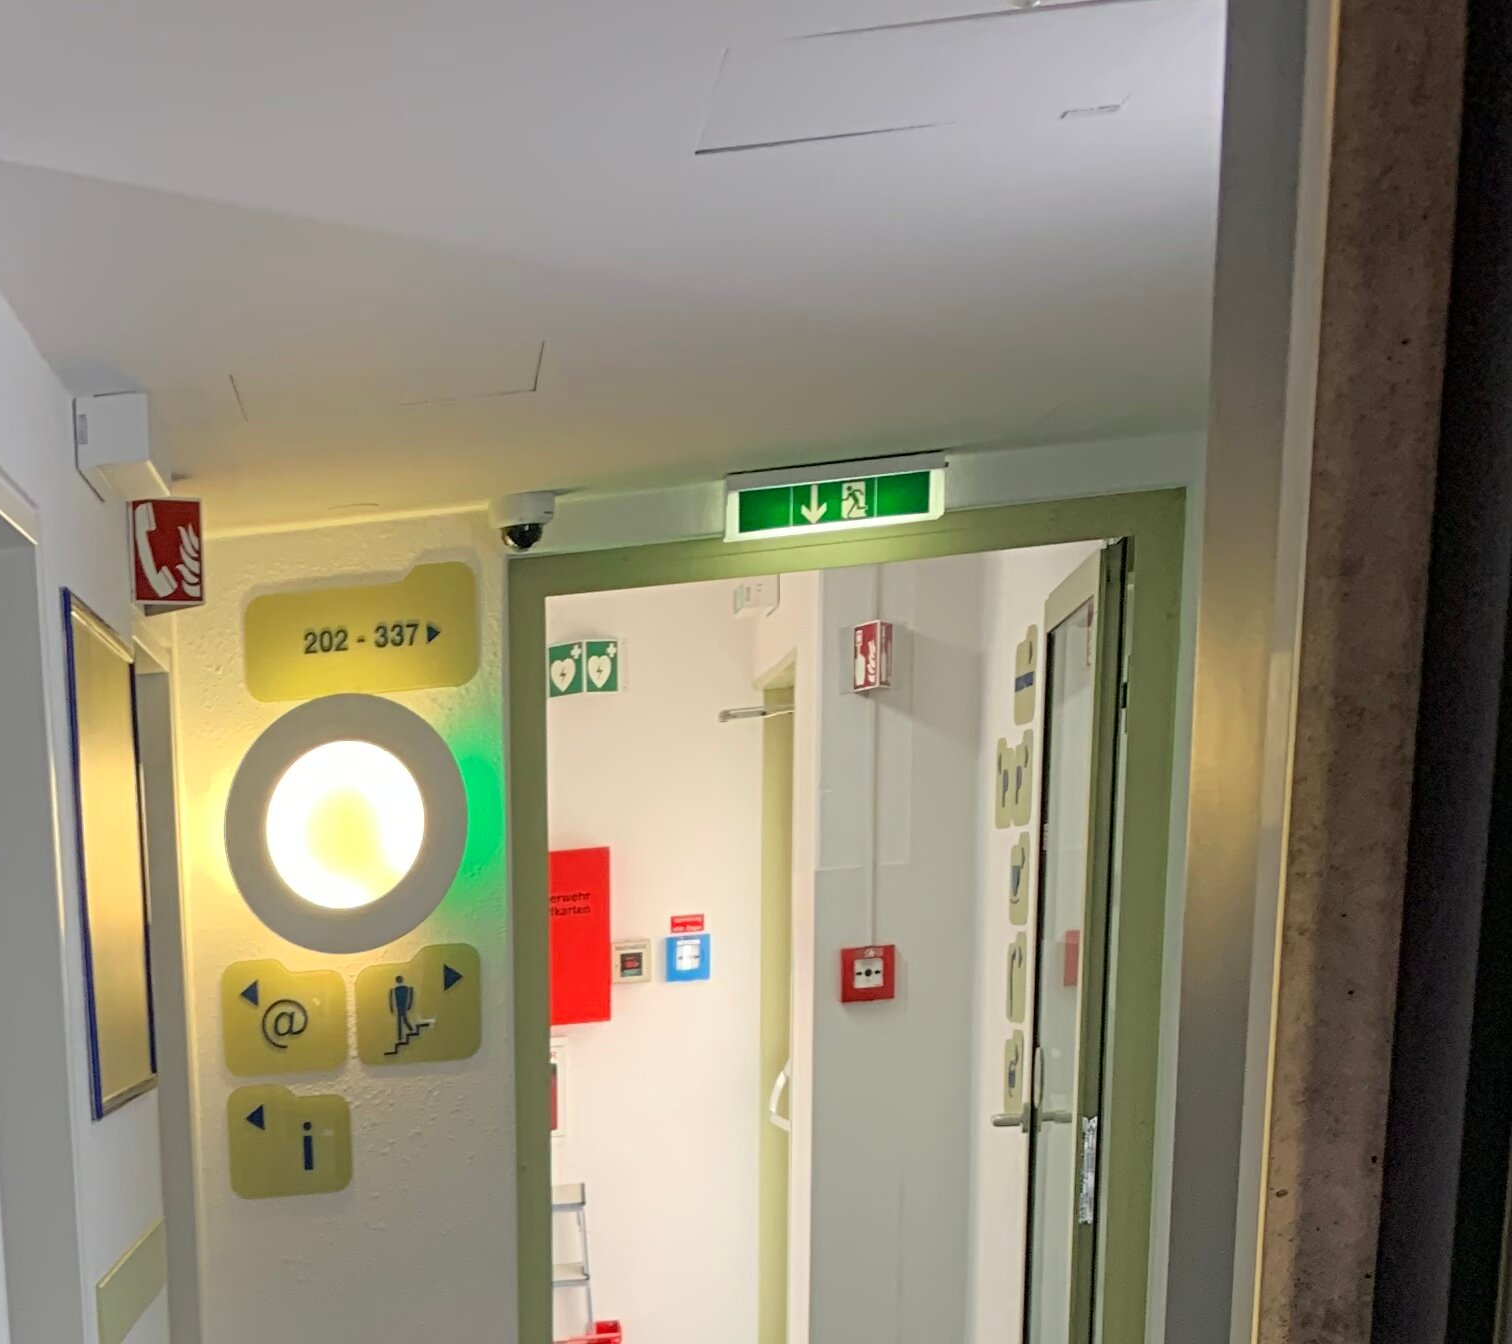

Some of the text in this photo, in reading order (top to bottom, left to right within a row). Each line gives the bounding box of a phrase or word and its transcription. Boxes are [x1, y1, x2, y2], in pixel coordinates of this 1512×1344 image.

[304, 629, 348, 654] 202
[374, 623, 419, 648] 337
[550, 892, 591, 903] erwehr
[262, 999, 308, 1048] @
